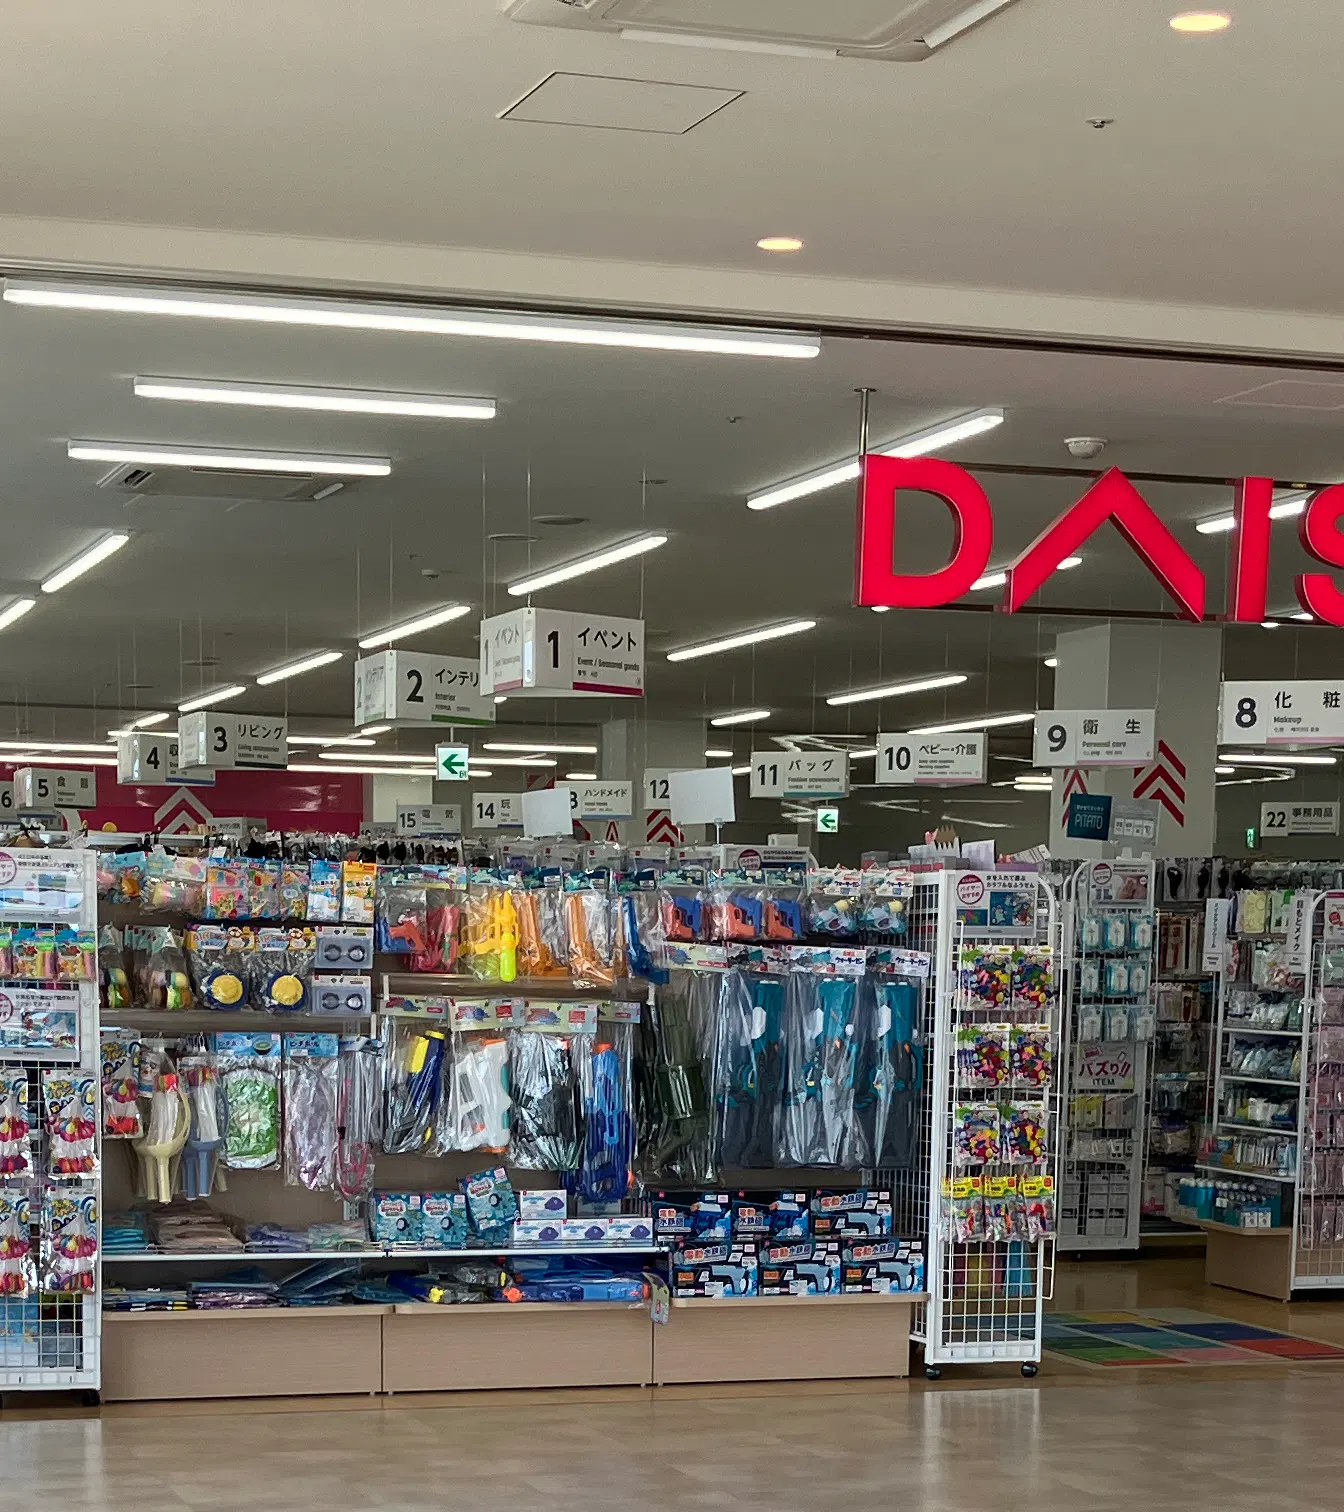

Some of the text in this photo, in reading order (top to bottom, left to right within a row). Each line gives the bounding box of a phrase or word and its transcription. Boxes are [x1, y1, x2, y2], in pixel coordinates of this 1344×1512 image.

[547, 627, 637, 668] 1 イベント
[406, 669, 424, 702] 2
[1235, 690, 1341, 728] 8 化粧
[213, 723, 284, 752] 3 リビング
[1047, 719, 1141, 752] 9 衛生
[146, 746, 160, 770] 4
[885, 746, 911, 771] 10
[757, 759, 835, 786] 11 バッグ
[1, 790, 12, 809] 6
[38, 778, 49, 798] 5
[584, 788, 627, 798] ハンドメイド
[649, 779, 670, 799] 12
[399, 812, 416, 829] 15
[476, 802, 495, 820] 14
[1266, 811, 1287, 828] 22
[1292, 807, 1334, 818] 事務用品
[1292, 899, 1304, 952] 目もとメイク
[1092, 1078, 1115, 1086] ITEM
